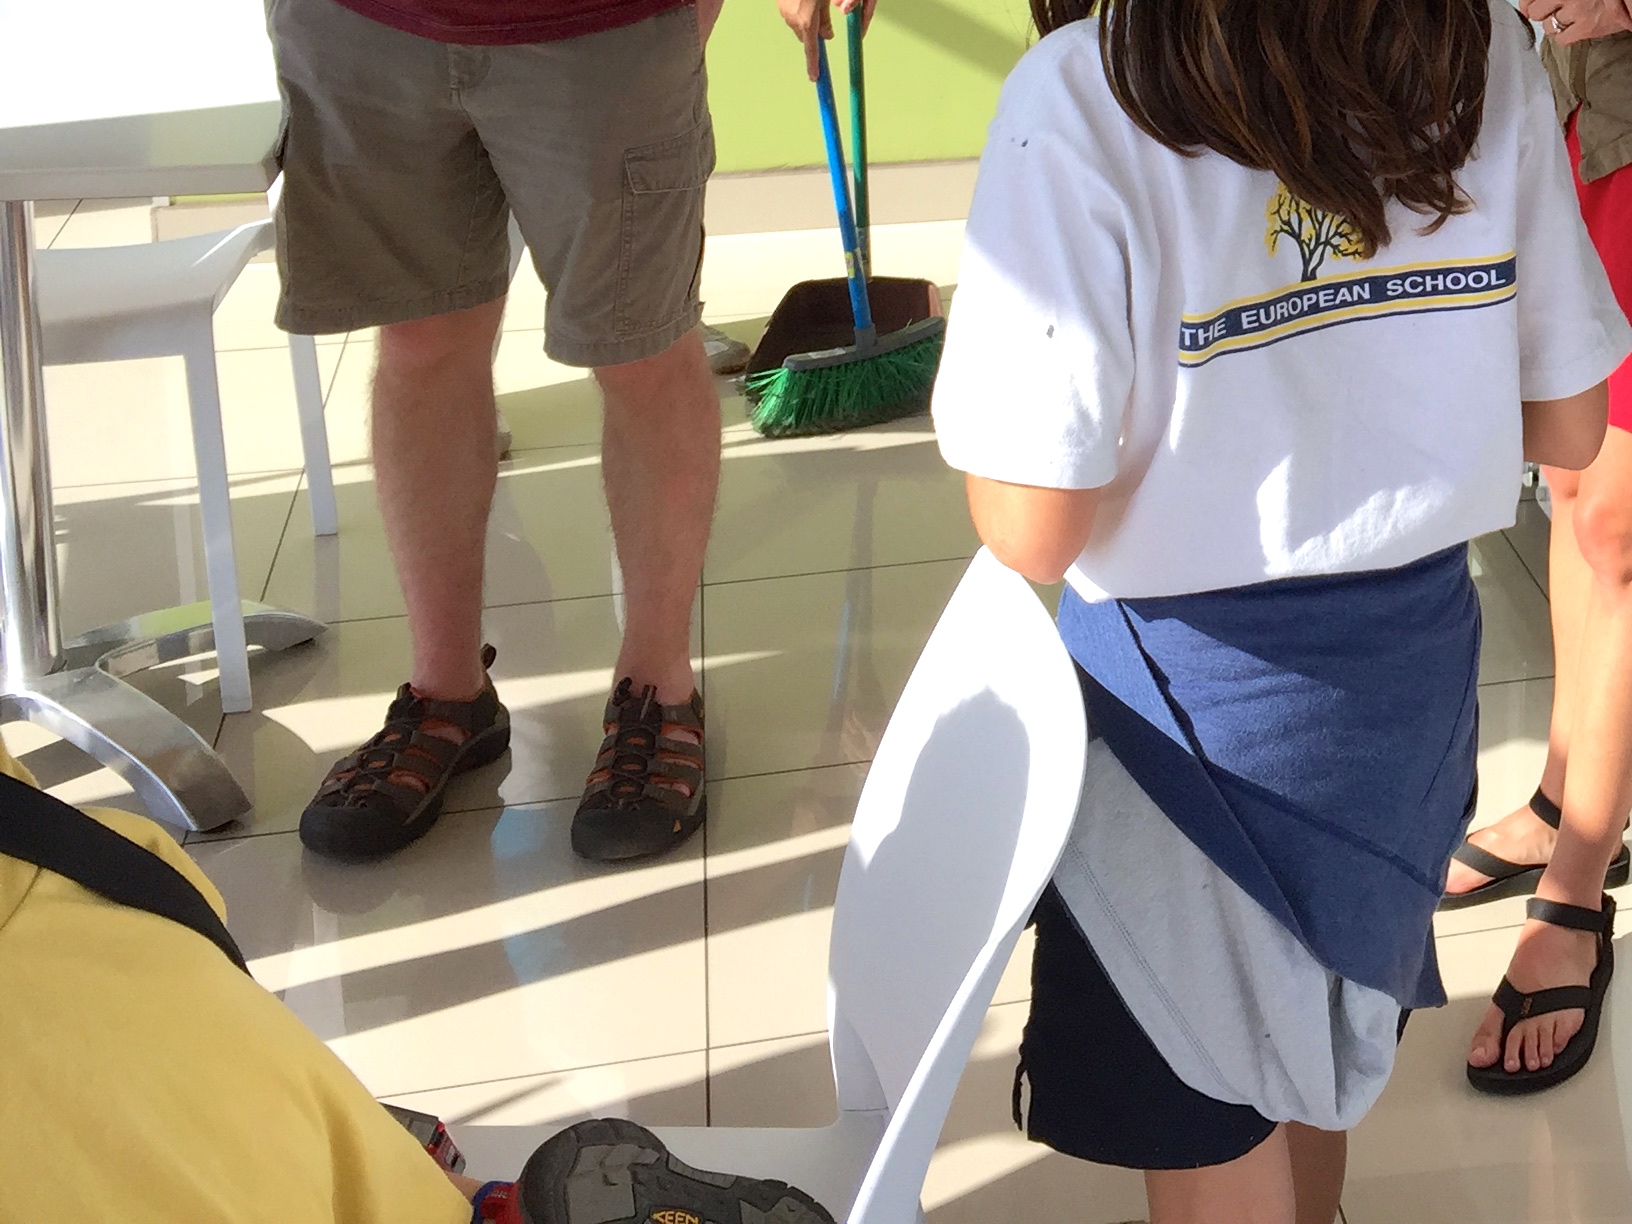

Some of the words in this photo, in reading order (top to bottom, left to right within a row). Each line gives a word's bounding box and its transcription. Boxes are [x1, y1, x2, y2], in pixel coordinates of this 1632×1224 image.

[1181, 317, 1227, 347] THE
[1240, 282, 1371, 331] EUROPEAN
[1386, 268, 1507, 297] SCHOOL
